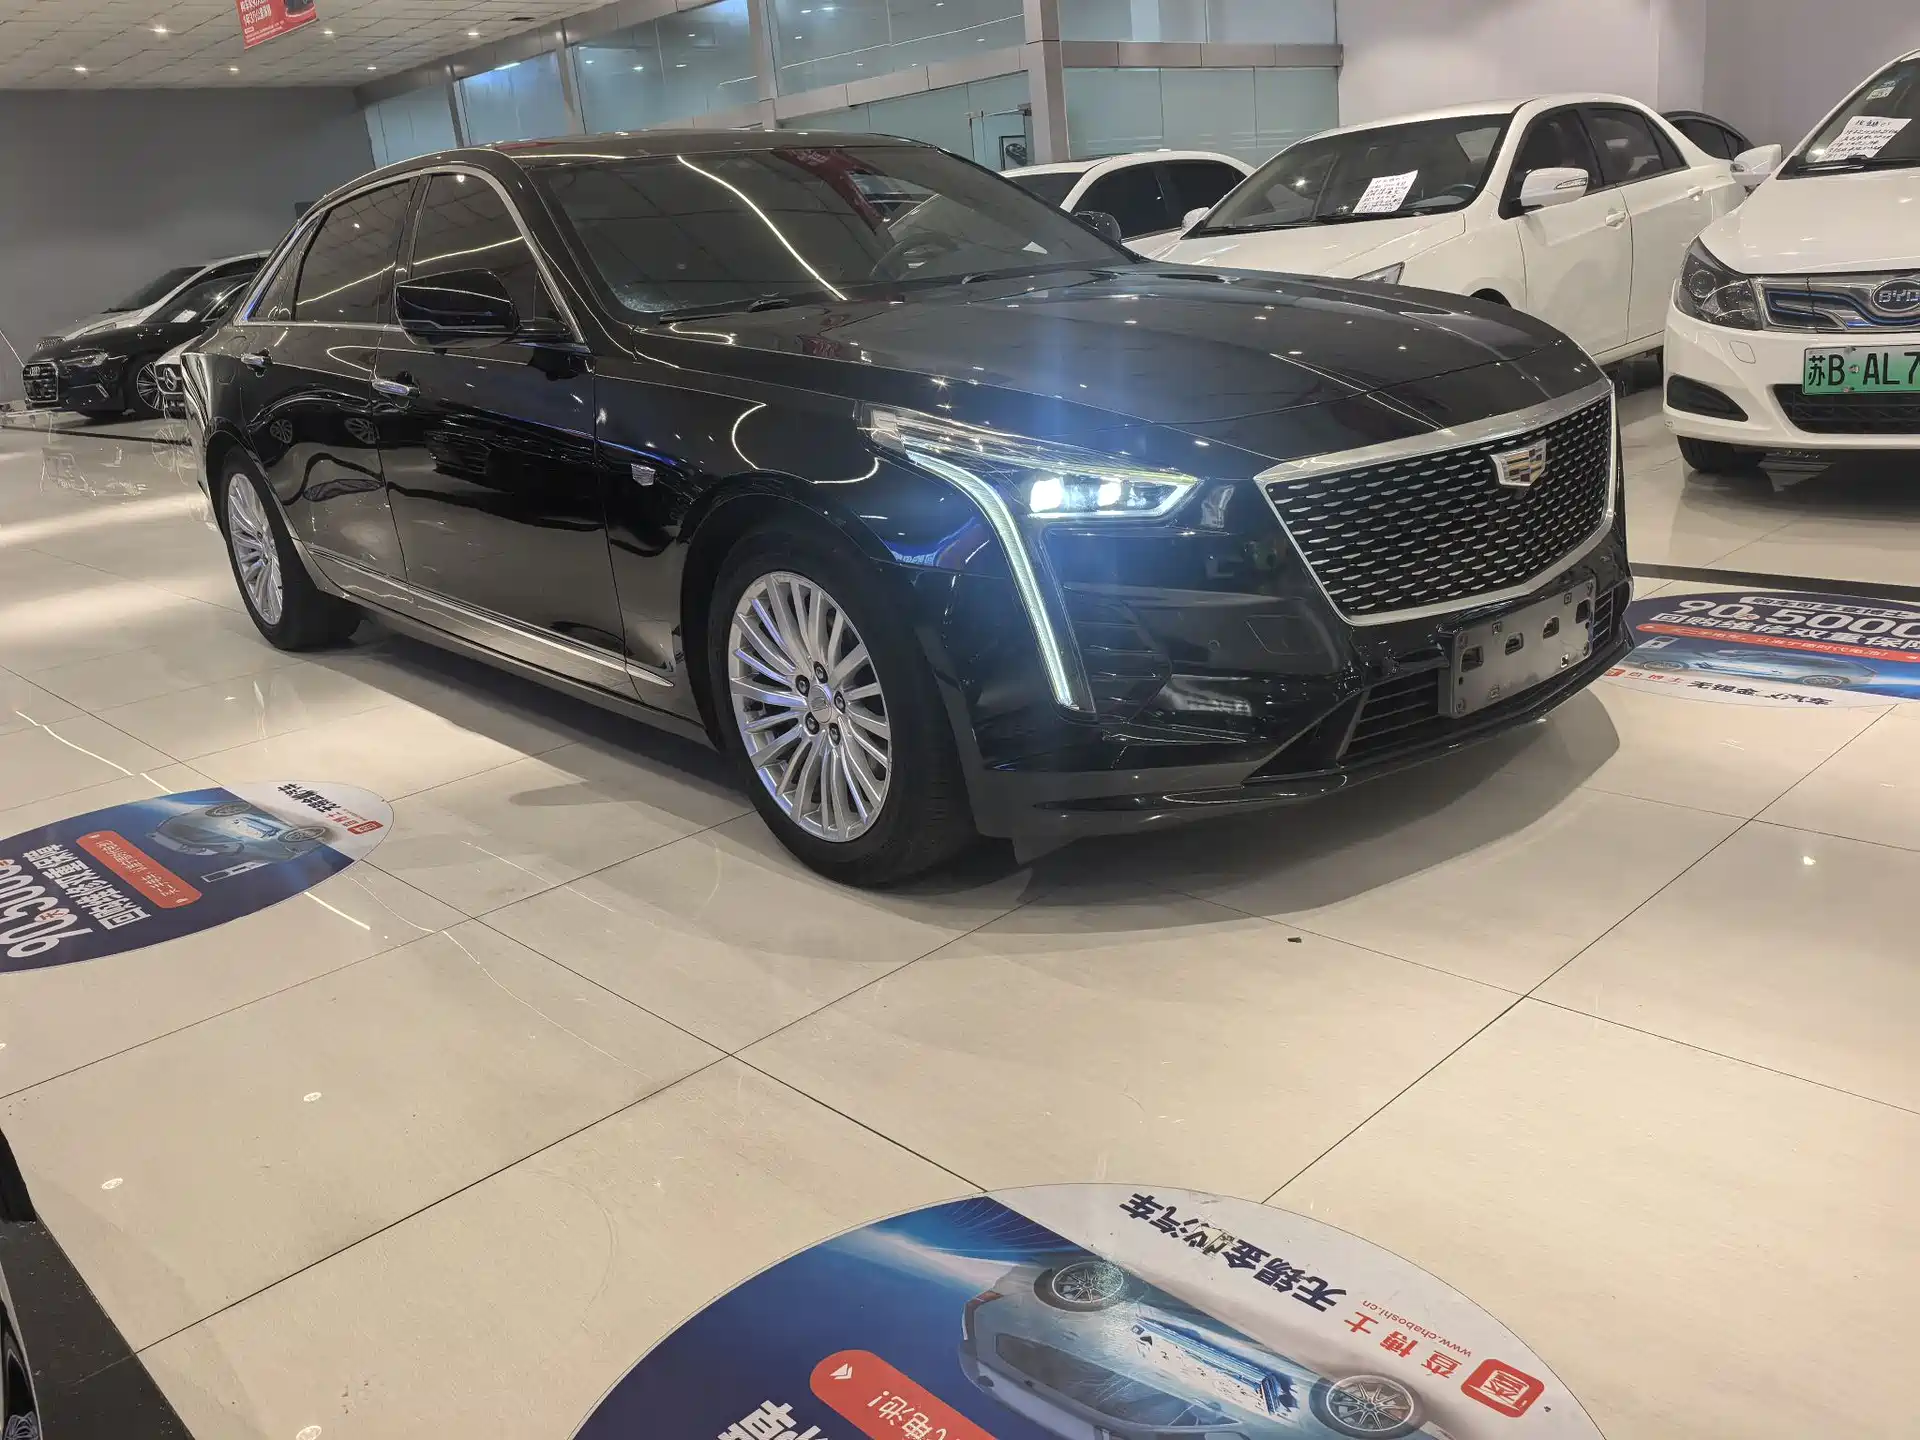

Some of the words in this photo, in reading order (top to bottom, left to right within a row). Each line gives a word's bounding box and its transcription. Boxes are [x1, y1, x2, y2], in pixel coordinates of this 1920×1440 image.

[1879, 288, 1920, 303] BYD
[22, 844, 151, 930] 回购维修双重保障
[1344, 1311, 1463, 1380] 查博士
[1361, 1299, 1472, 1358] www.chaboshi.cn
